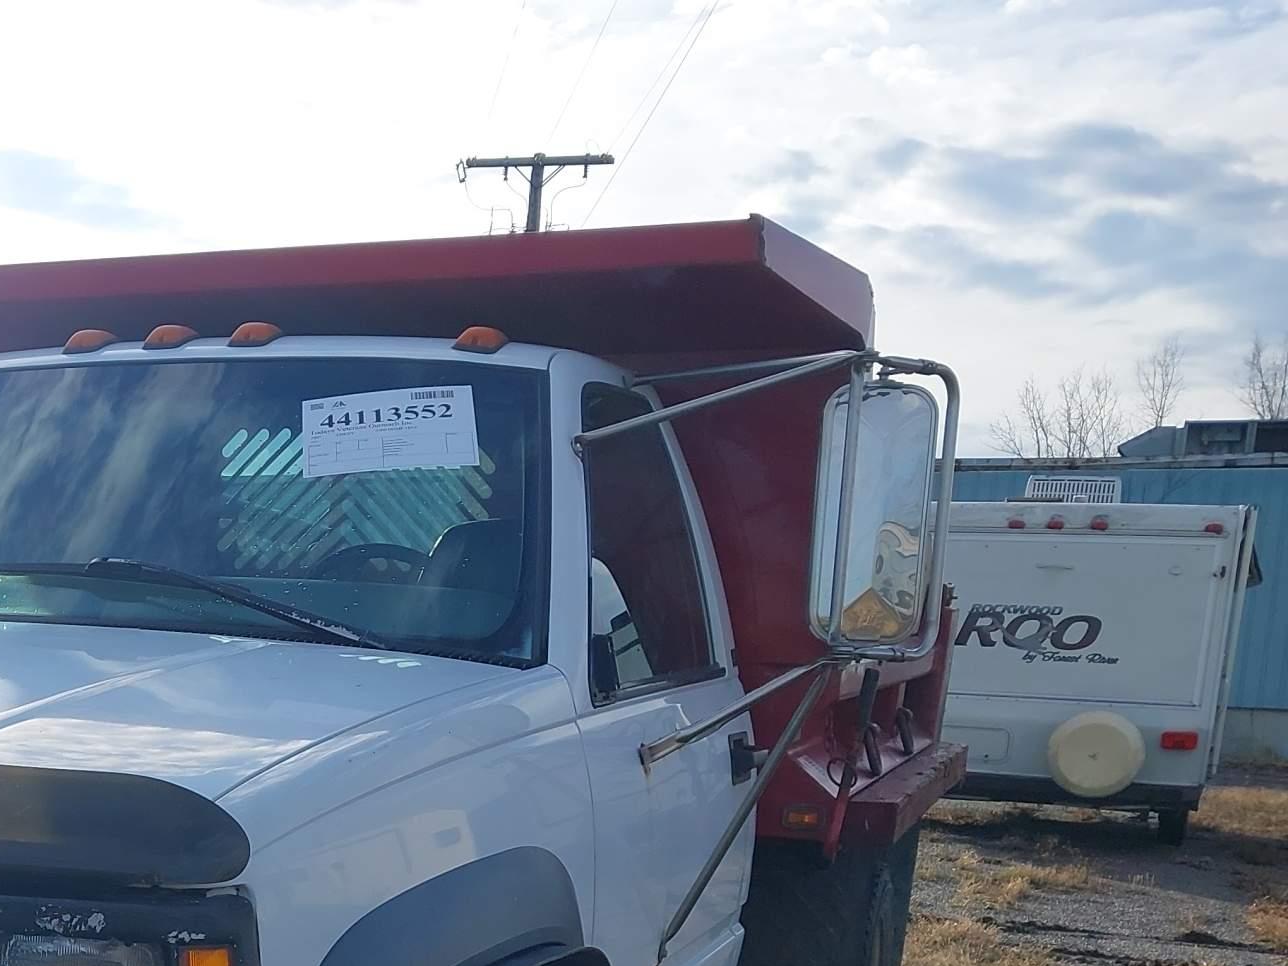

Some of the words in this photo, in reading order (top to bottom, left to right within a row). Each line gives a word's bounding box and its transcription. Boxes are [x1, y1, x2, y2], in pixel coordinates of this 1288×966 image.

[319, 403, 454, 428] 44113552
[970, 603, 1064, 616] ROCKWOOD
[1021, 651, 1038, 664] by
